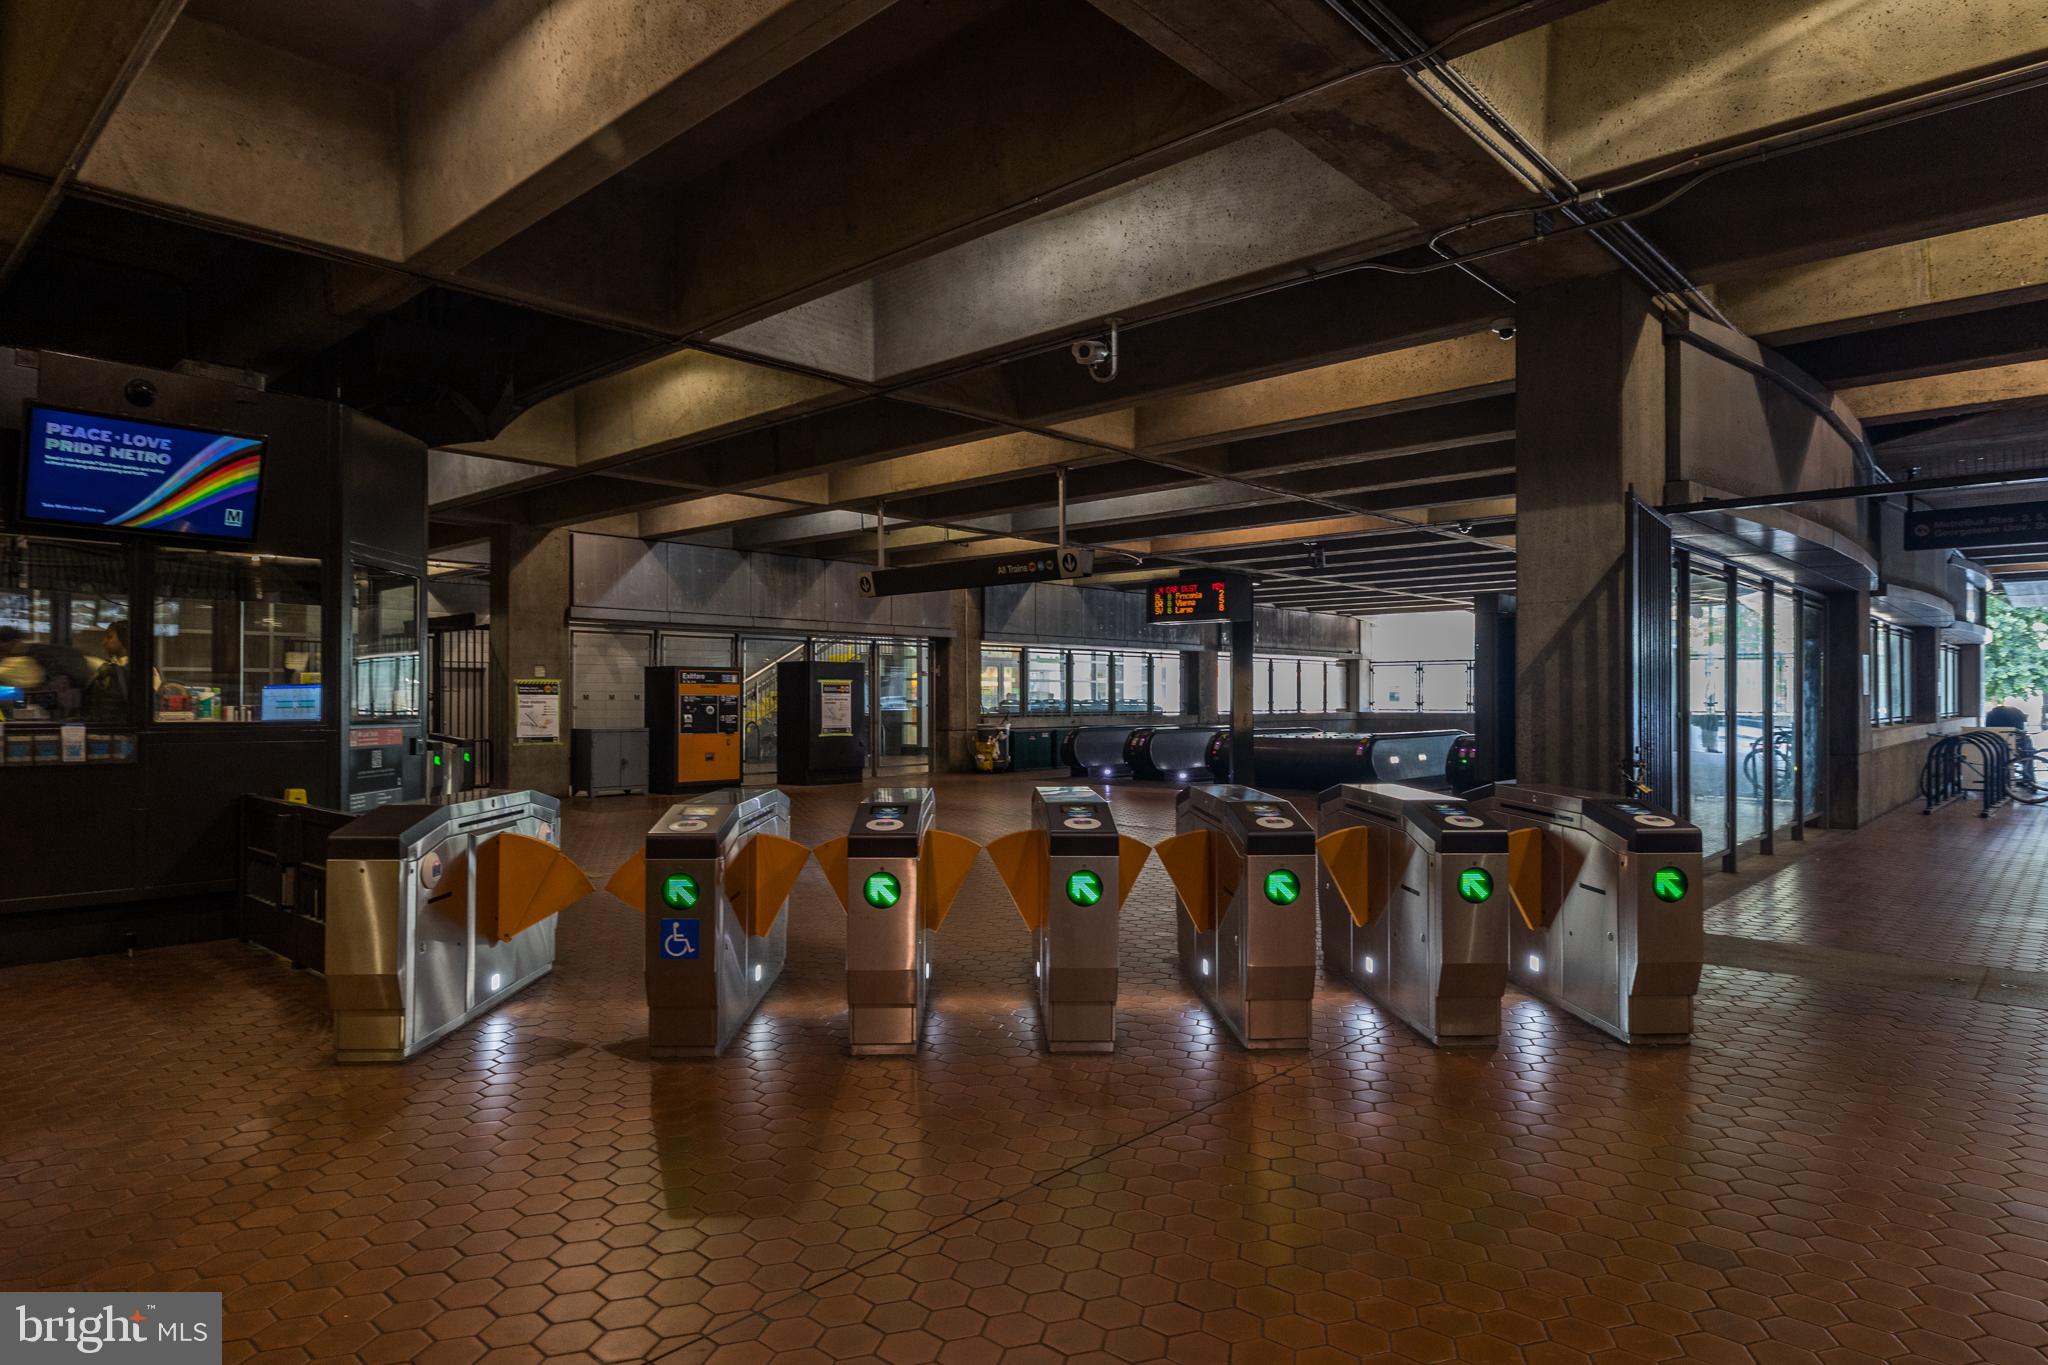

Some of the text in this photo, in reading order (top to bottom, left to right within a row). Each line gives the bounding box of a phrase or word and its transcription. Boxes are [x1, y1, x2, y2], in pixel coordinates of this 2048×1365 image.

[46, 422, 112, 443] PEACE
[122, 433, 172, 451] LOVE
[45, 438, 105, 457] PRIDE
[109, 446, 172, 465] METRO
[997, 565, 1007, 575] All
[1007, 564, 1028, 574] Trains
[1181, 584, 1198, 593] DEST
[1218, 589, 1225, 597] 2
[1175, 599, 1197, 607] Vienna
[1218, 596, 1225, 604] 5
